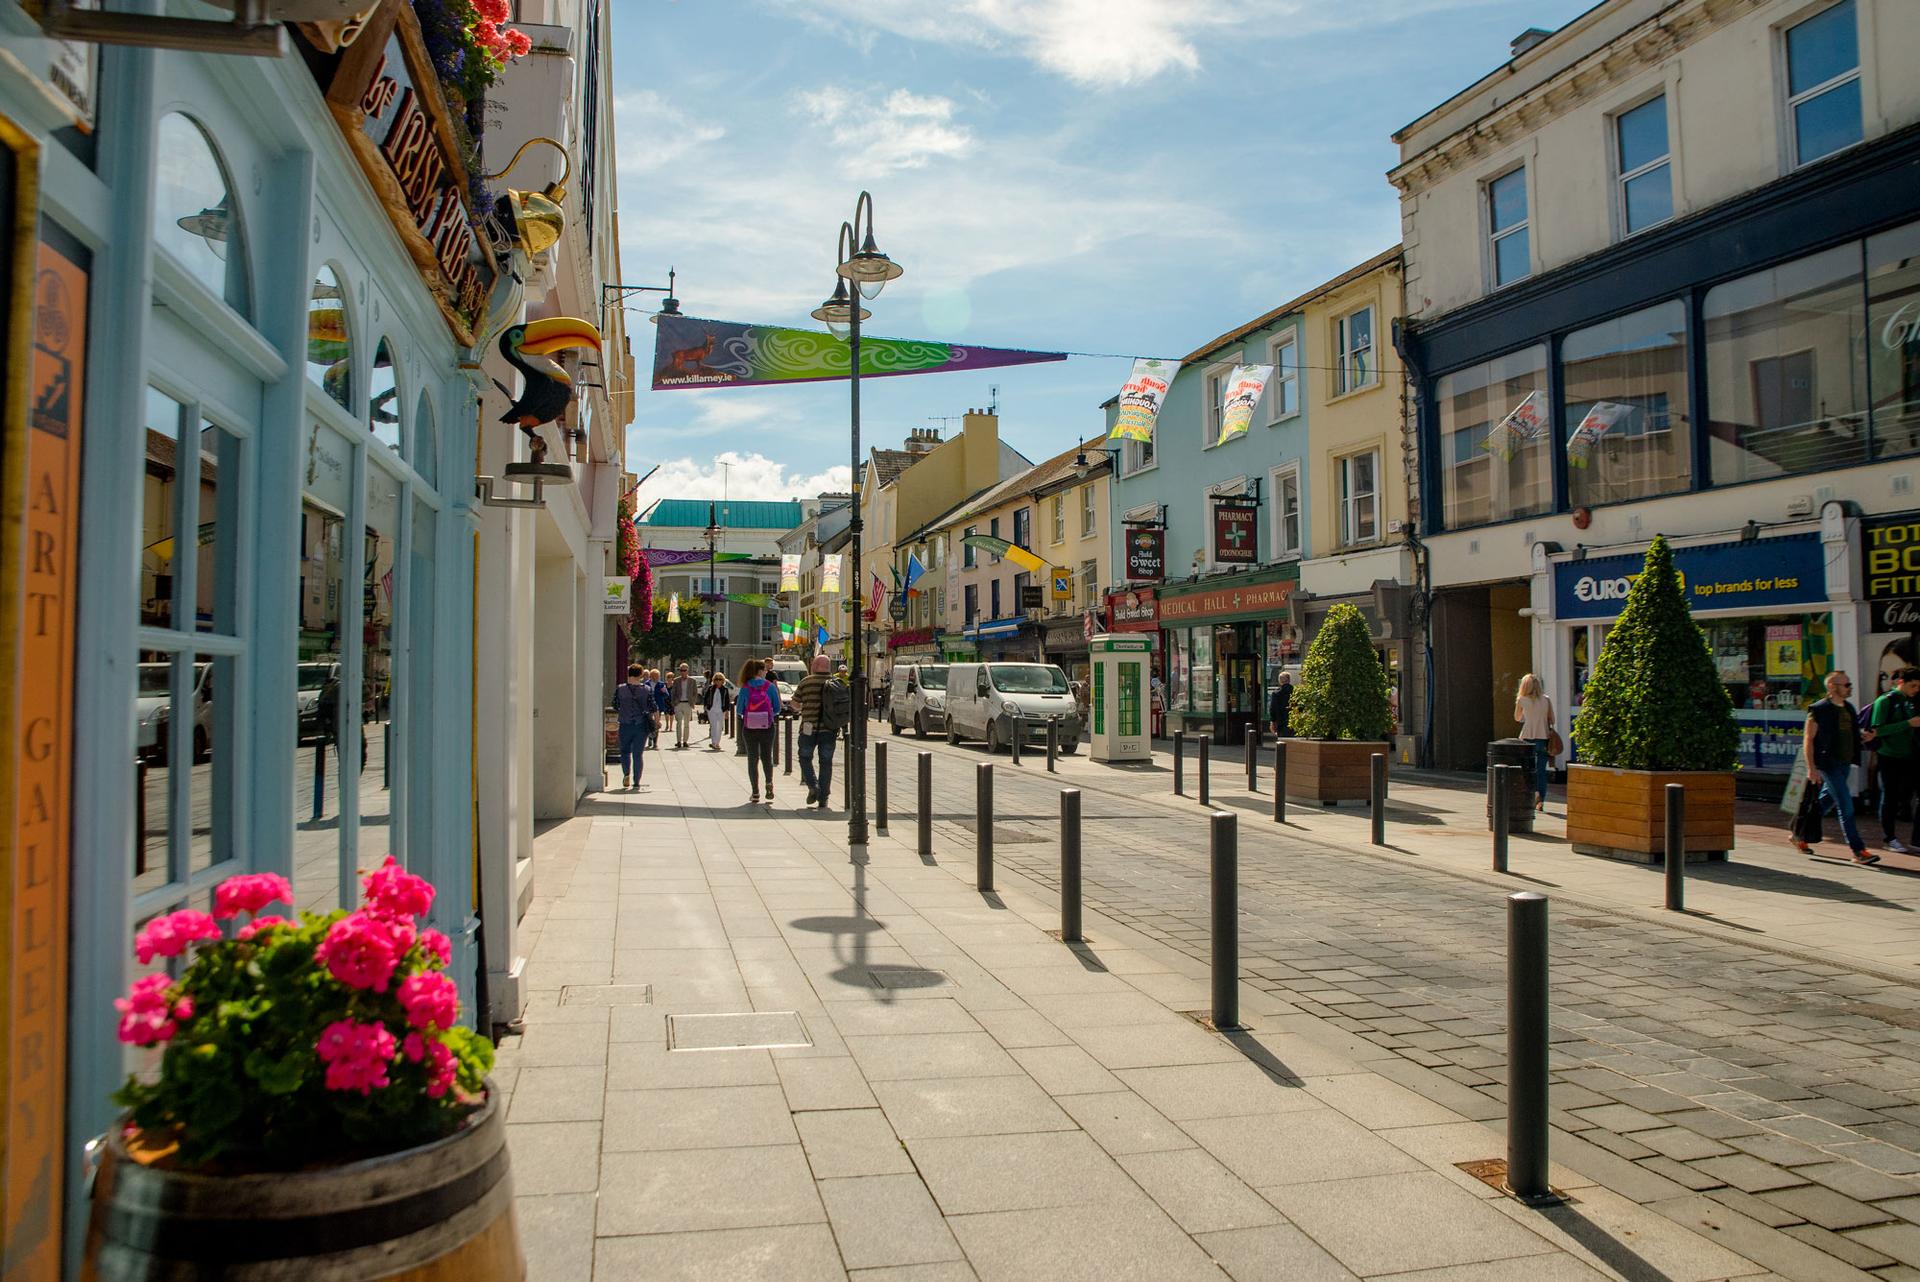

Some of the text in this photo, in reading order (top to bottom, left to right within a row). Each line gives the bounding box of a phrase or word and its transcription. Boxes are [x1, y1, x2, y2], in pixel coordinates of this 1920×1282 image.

[661, 373, 733, 385] www.killarney.ie
[1218, 511, 1253, 522] PHARMACY
[28, 471, 58, 636] ART
[1130, 555, 1161, 568] Sweet
[1138, 565, 1154, 576] Shop
[1694, 576, 1799, 597] top brands for less
[1160, 590, 1289, 616] MEDICAL HALL PHARMAC
[1140, 606, 1155, 618] Shop
